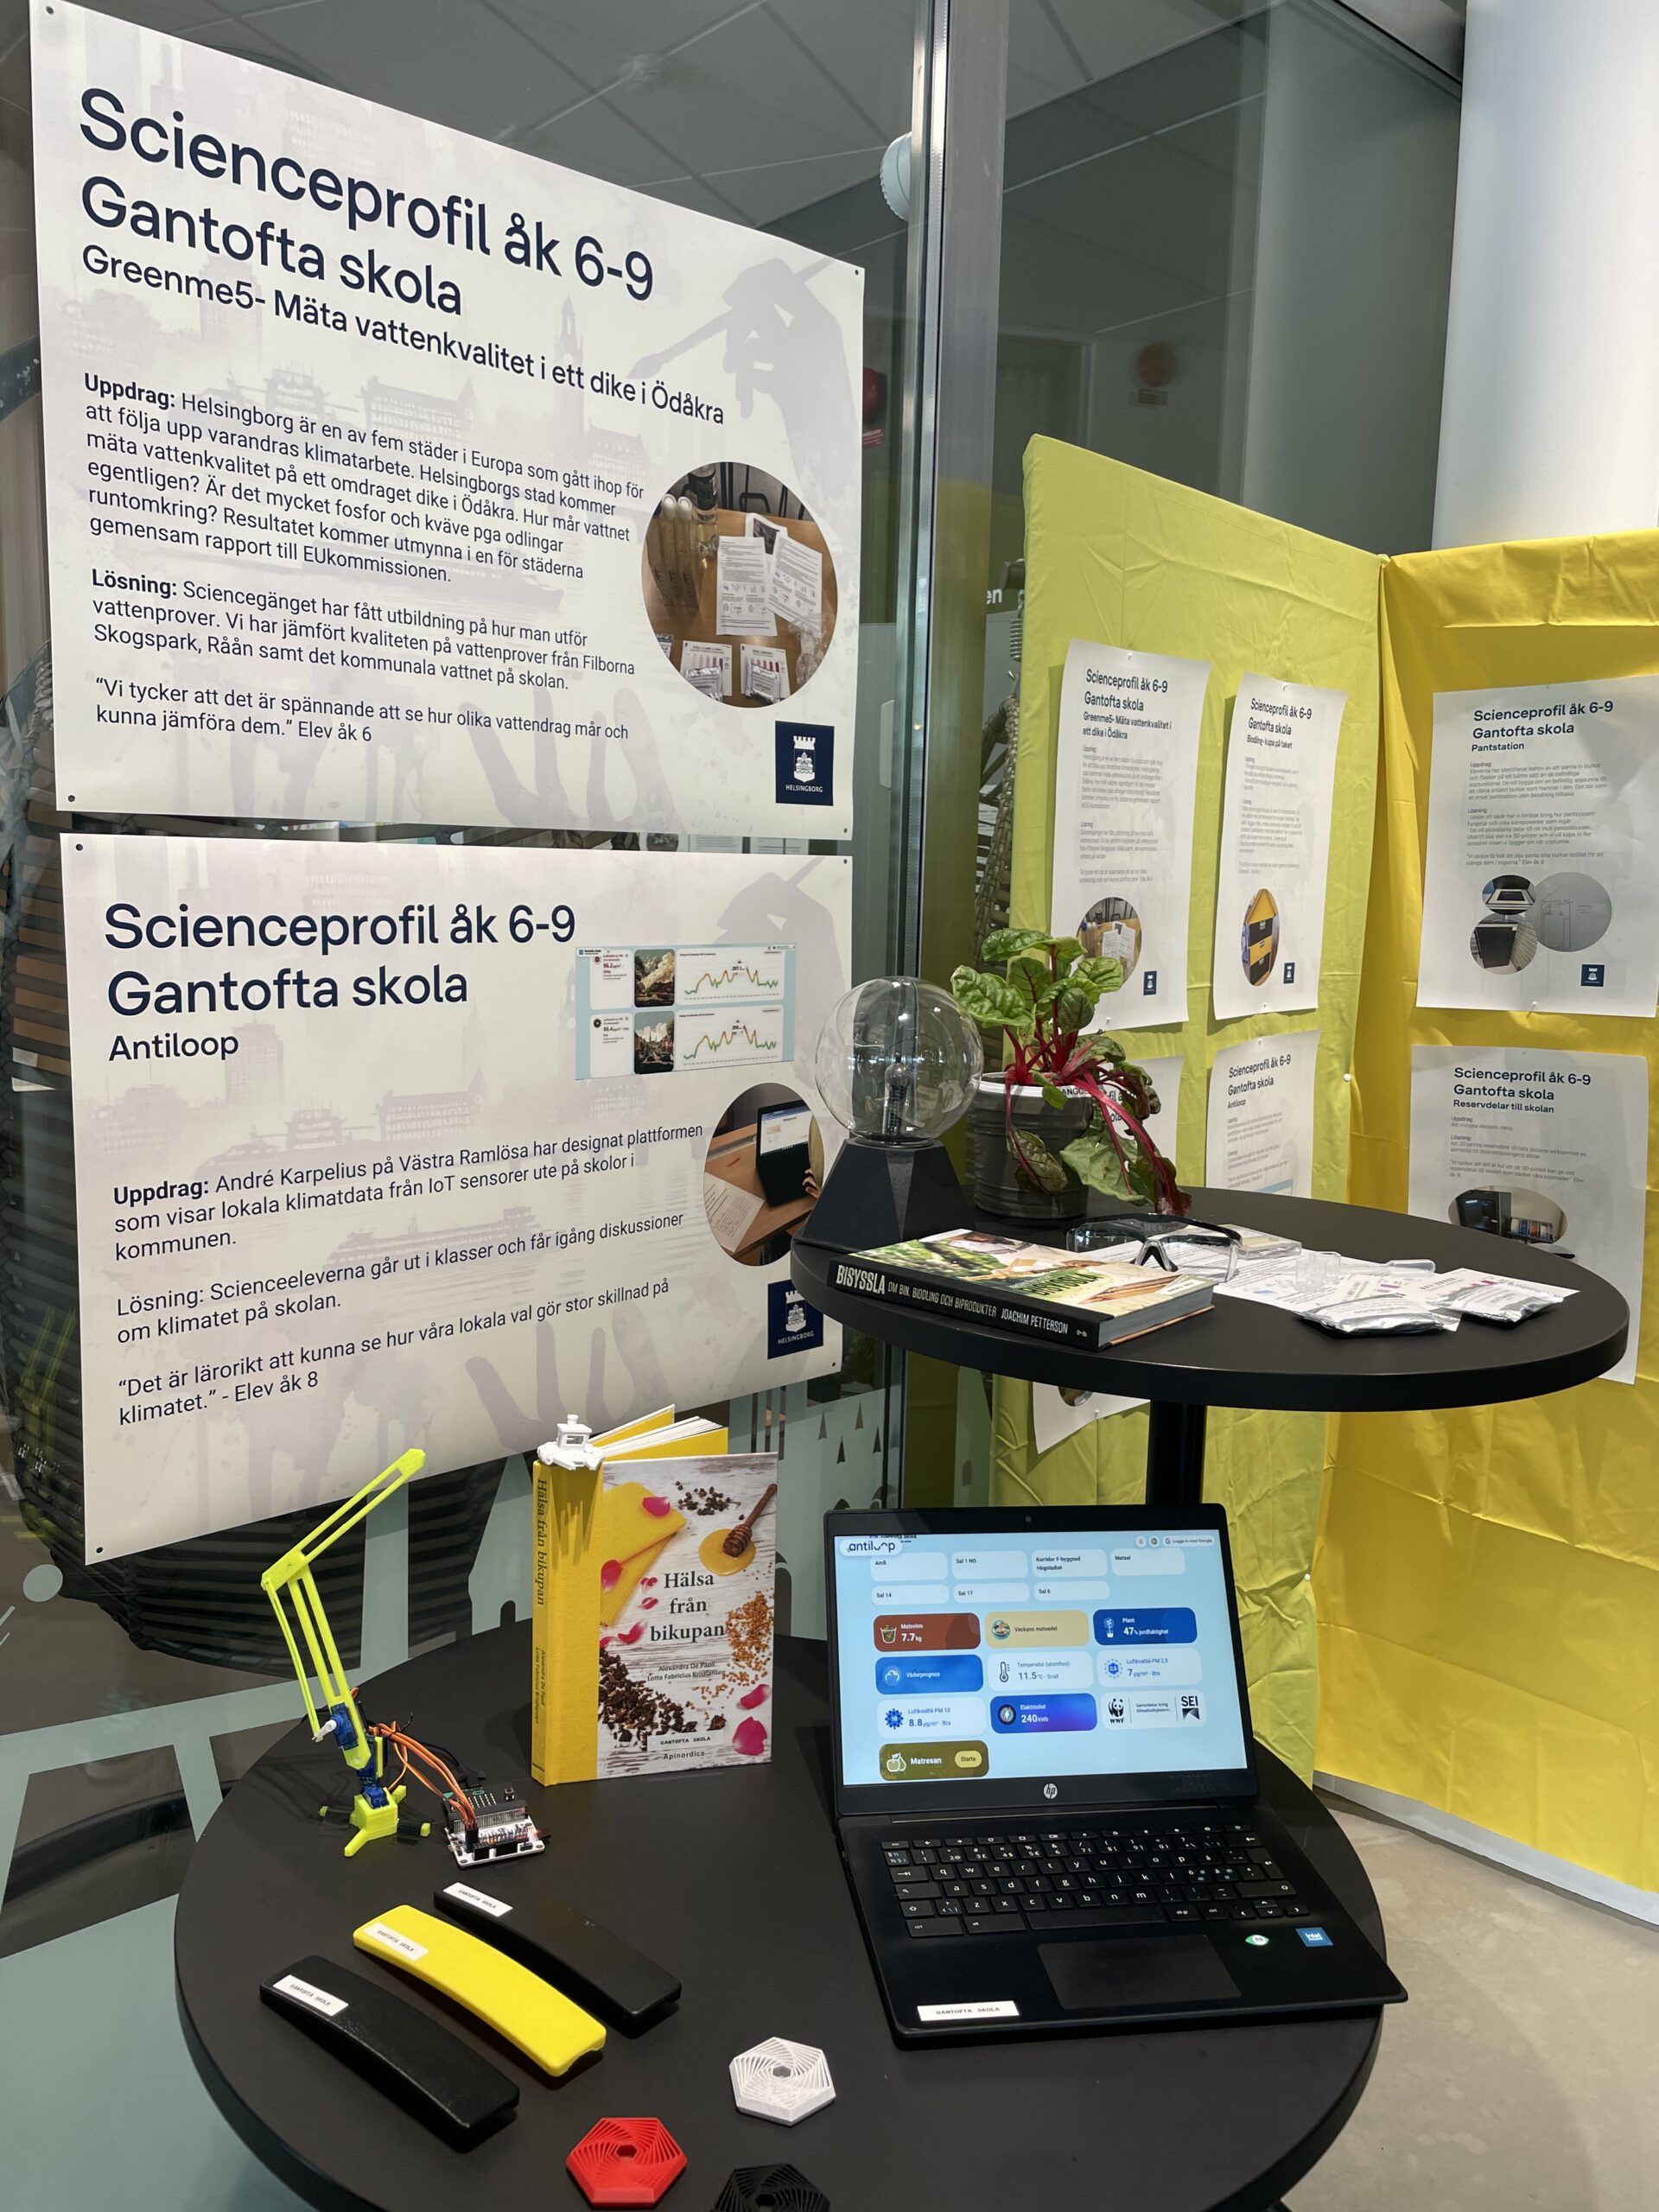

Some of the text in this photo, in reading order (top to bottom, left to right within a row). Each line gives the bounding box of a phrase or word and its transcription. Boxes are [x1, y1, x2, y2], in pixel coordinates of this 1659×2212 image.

[79, 88, 653, 301] Scienceprofil åk 6-9
[81, 175, 461, 316] Gantofta skola
[83, 244, 724, 425] Greenme5- Mäta vattenkvalitet i ett dike i Ödåkra
[85, 372, 644, 499] Uppdrag: Helsingborg är en av fem städer i Europa som gått ihop för
[90, 517, 451, 582] gemensam rapport till EUkommissionen.
[92, 600, 634, 675] vattenprover. Vi har jämfört kvaliteten på vattenprover från Filborna
[1086, 669, 1168, 693] Scienceprofil åk 6-9
[1084, 691, 1144, 711] Gantofta skola
[1251, 698, 1312, 720] Scienceprofil åk 6-9
[1474, 701, 1613, 721] Scienceprofil åk 6-9
[1130, 719, 1168, 729] vattenkvalitet
[1249, 717, 1291, 735] Gantofta skola
[1473, 722, 1573, 739] Gantofta skola
[1471, 742, 1524, 752] Pantstation
[785, 784, 823, 793] HELSINGBORG
[105, 903, 575, 956] Scienceprofil åk 6-9
[108, 963, 467, 1016] Gantofta skola
[109, 1032, 238, 1061] Antiloop
[1229, 1054, 1291, 1078] Scienceprofil åk 6-9
[1454, 1067, 1591, 1085] Scienceprofil åk 6-9
[1228, 1076, 1274, 1096] Gantofta skola
[1453, 1084, 1554, 1100] Gantofta skola
[1228, 1099, 1246, 1109] Antiloop
[1453, 1099, 1510, 1109] Reservdelar
[1524, 1104, 1554, 1113] skolan
[114, 1125, 702, 1208] Uppdrag: André Karpelius på Västra Ramlösa har designat plattformen
[836, 1264, 885, 1295] BISYSSLA
[887, 1281, 898, 1293] OM
[940, 1292, 953, 1306] OCH
[955, 1294, 996, 1319] BIPRODUKTER
[1001, 1307, 1029, 1325] JOACHIM
[1030, 1314, 1068, 1334] PETTERSON
[778, 1331, 814, 1344] HELSINGBORG
[536, 1479, 547, 1605] Hälsa från bikupan
[664, 1571, 715, 1589] Hälsa
[670, 1598, 708, 1613] från
[650, 1624, 724, 1643] bikupan
[1181, 1696, 1198, 1707] SEI
[664, 1751, 705, 1760] Apinordica
